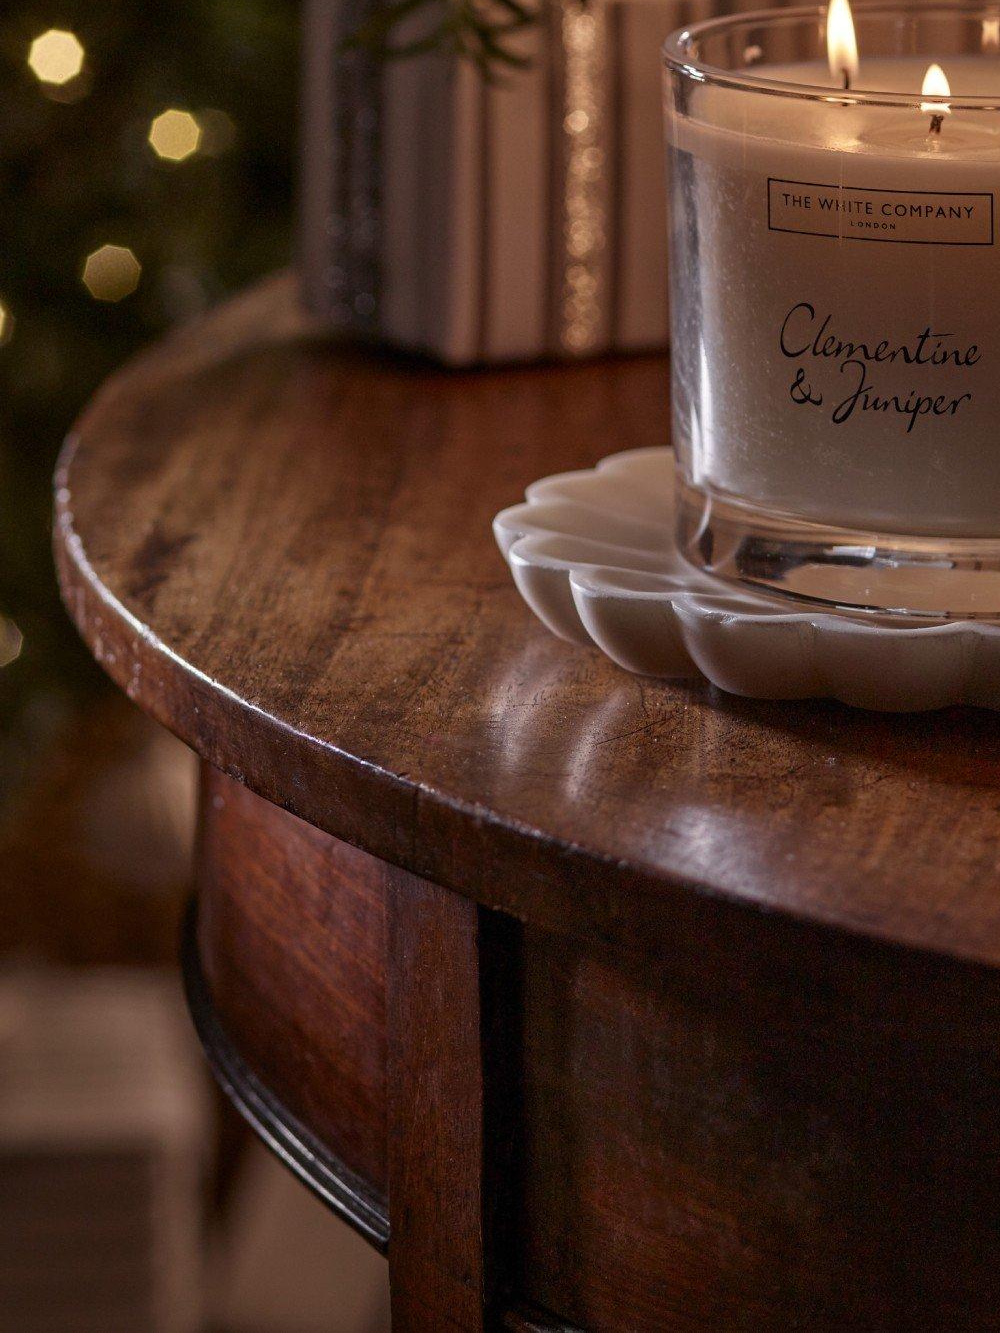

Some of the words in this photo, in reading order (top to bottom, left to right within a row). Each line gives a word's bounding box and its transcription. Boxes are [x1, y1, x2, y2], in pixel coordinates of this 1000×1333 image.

[782, 193, 811, 209] THE
[818, 197, 873, 215] WHITE
[881, 203, 974, 219] COMPANY
[850, 220, 896, 230] LONDON
[779, 302, 982, 367] Clementine
[790, 367, 823, 406] &
[832, 359, 972, 434] Juniper
